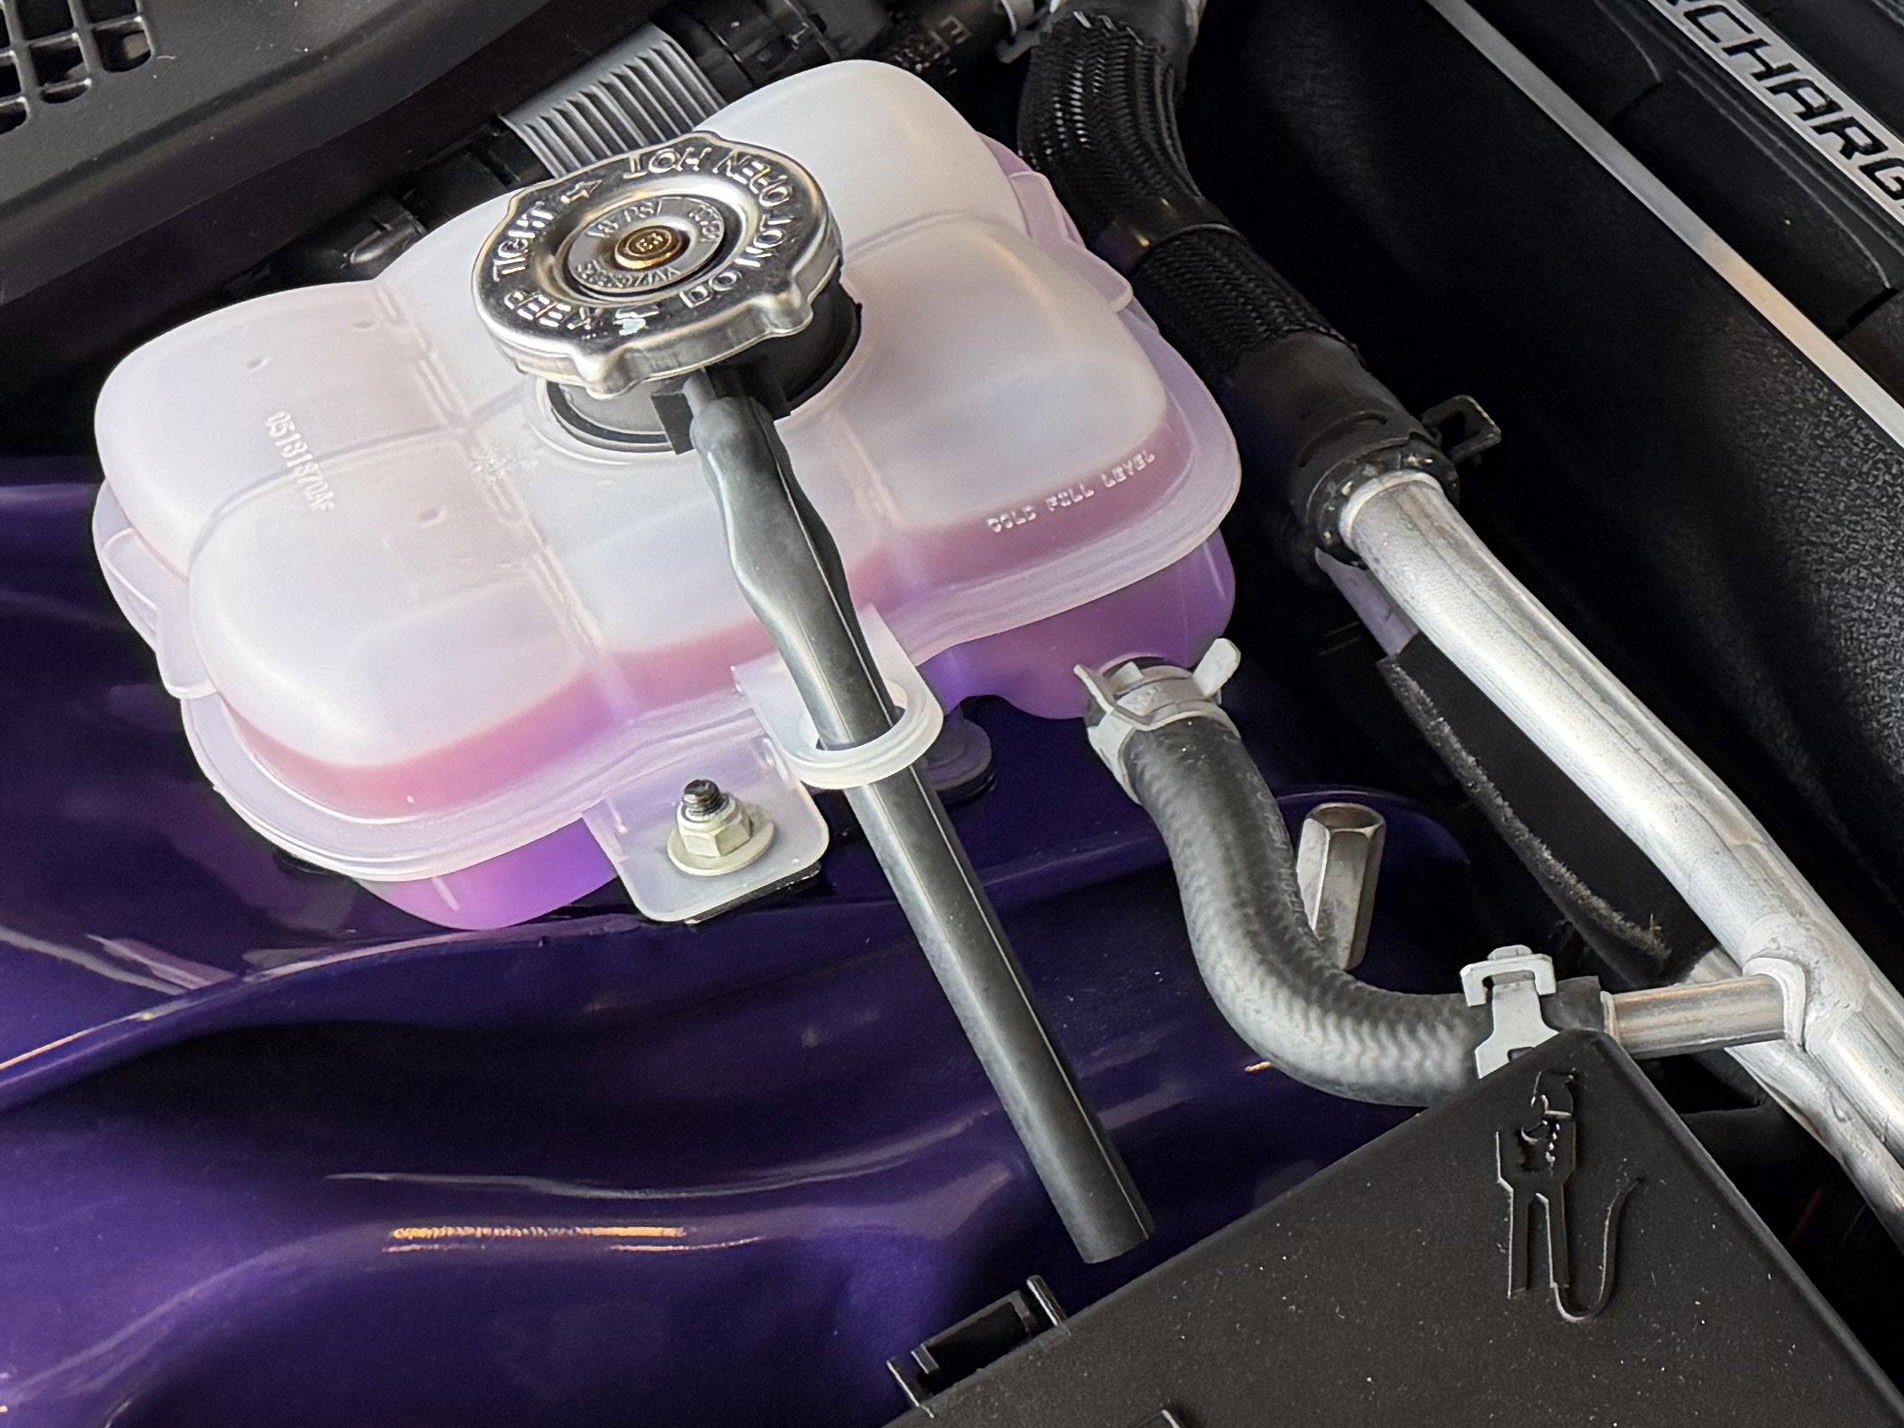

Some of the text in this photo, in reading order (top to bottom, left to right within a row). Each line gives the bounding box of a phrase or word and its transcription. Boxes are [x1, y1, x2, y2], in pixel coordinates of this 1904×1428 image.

[622, 146, 712, 180] HOT
[712, 150, 796, 209] OPEN
[492, 200, 605, 332] KEEP TIGHT
[735, 213, 793, 269] NOT
[679, 270, 744, 309] DO
[986, 449, 1157, 534] COLD FILL LEVEL
